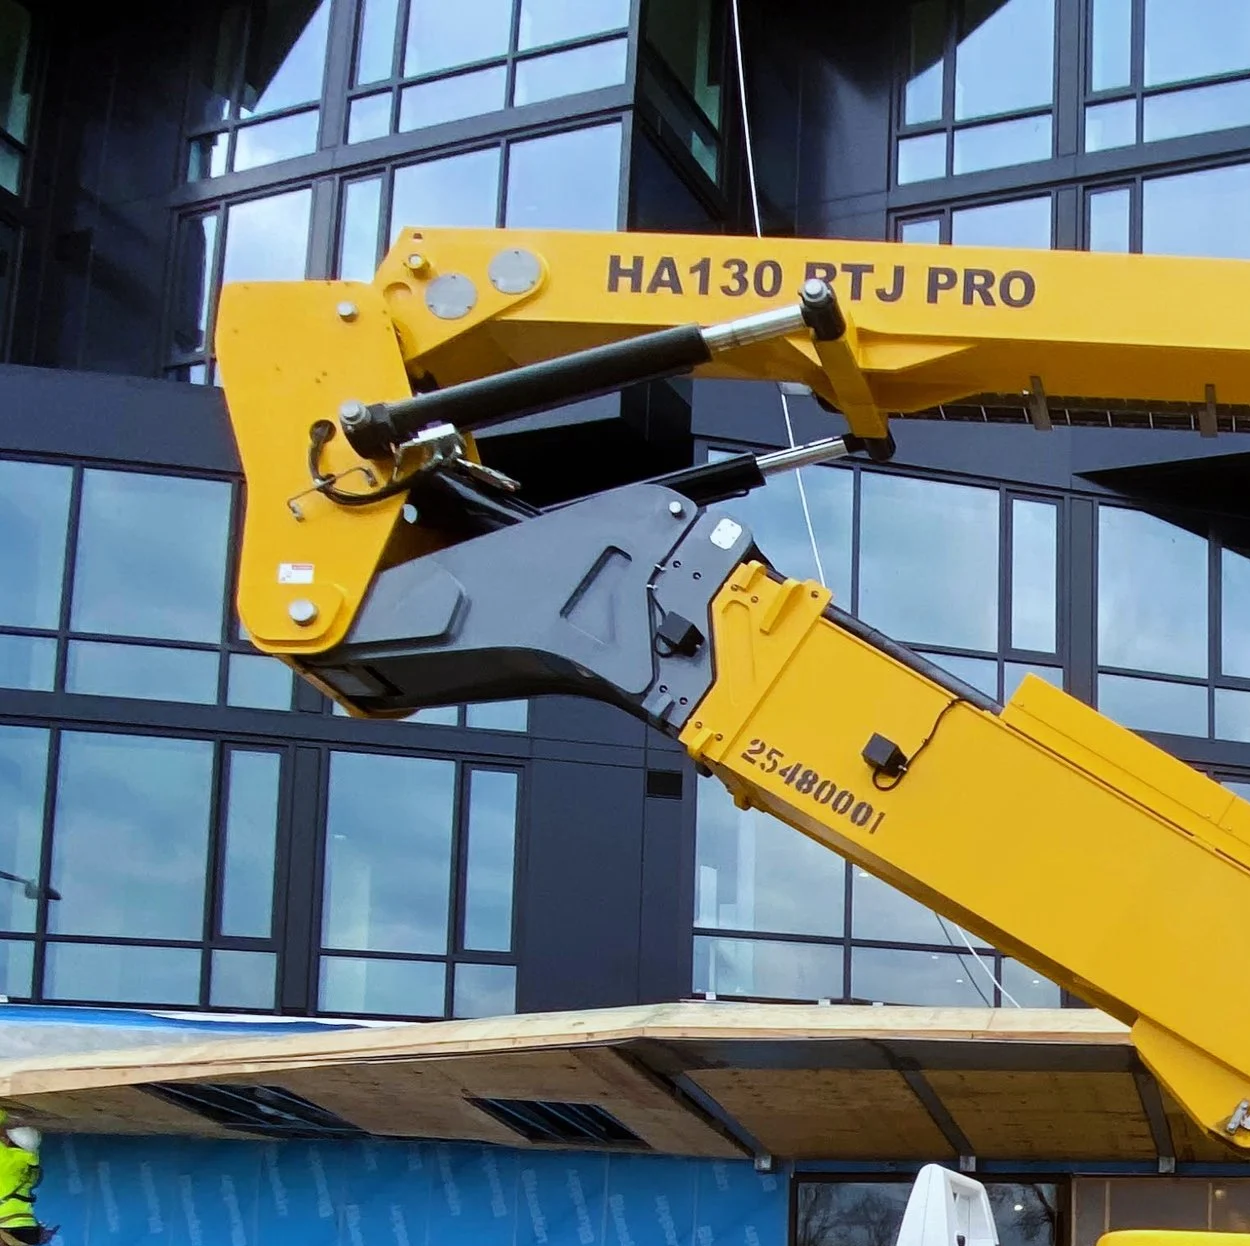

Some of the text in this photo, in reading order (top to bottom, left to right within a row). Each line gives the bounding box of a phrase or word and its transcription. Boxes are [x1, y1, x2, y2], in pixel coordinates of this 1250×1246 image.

[608, 255, 783, 298] HA130
[926, 266, 1037, 308] PRO
[740, 738, 886, 835] 25480001
